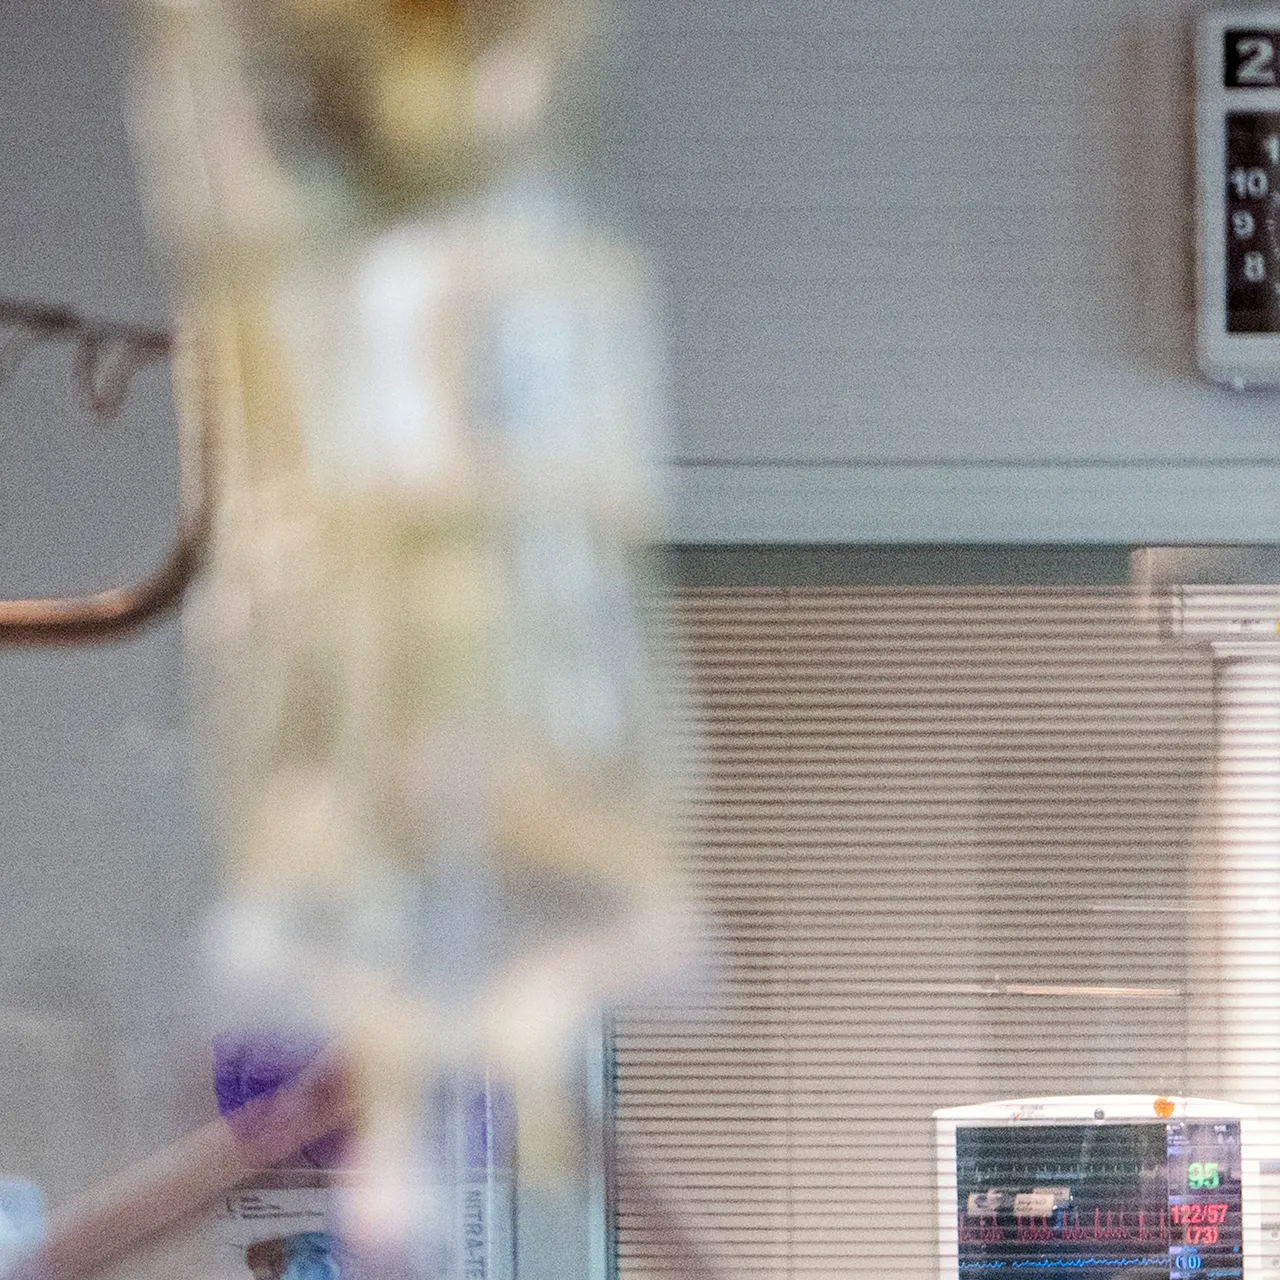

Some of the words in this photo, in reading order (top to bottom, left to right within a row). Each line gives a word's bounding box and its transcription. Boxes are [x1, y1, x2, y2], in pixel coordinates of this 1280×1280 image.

[1230, 168, 1268, 198] 10
[1232, 212, 1255, 239] 9
[1243, 250, 1266, 283] 8
[1187, 1161, 1220, 1190] 95
[1171, 1204, 1229, 1225] 122/57
[1185, 1226, 1219, 1245] (73)
